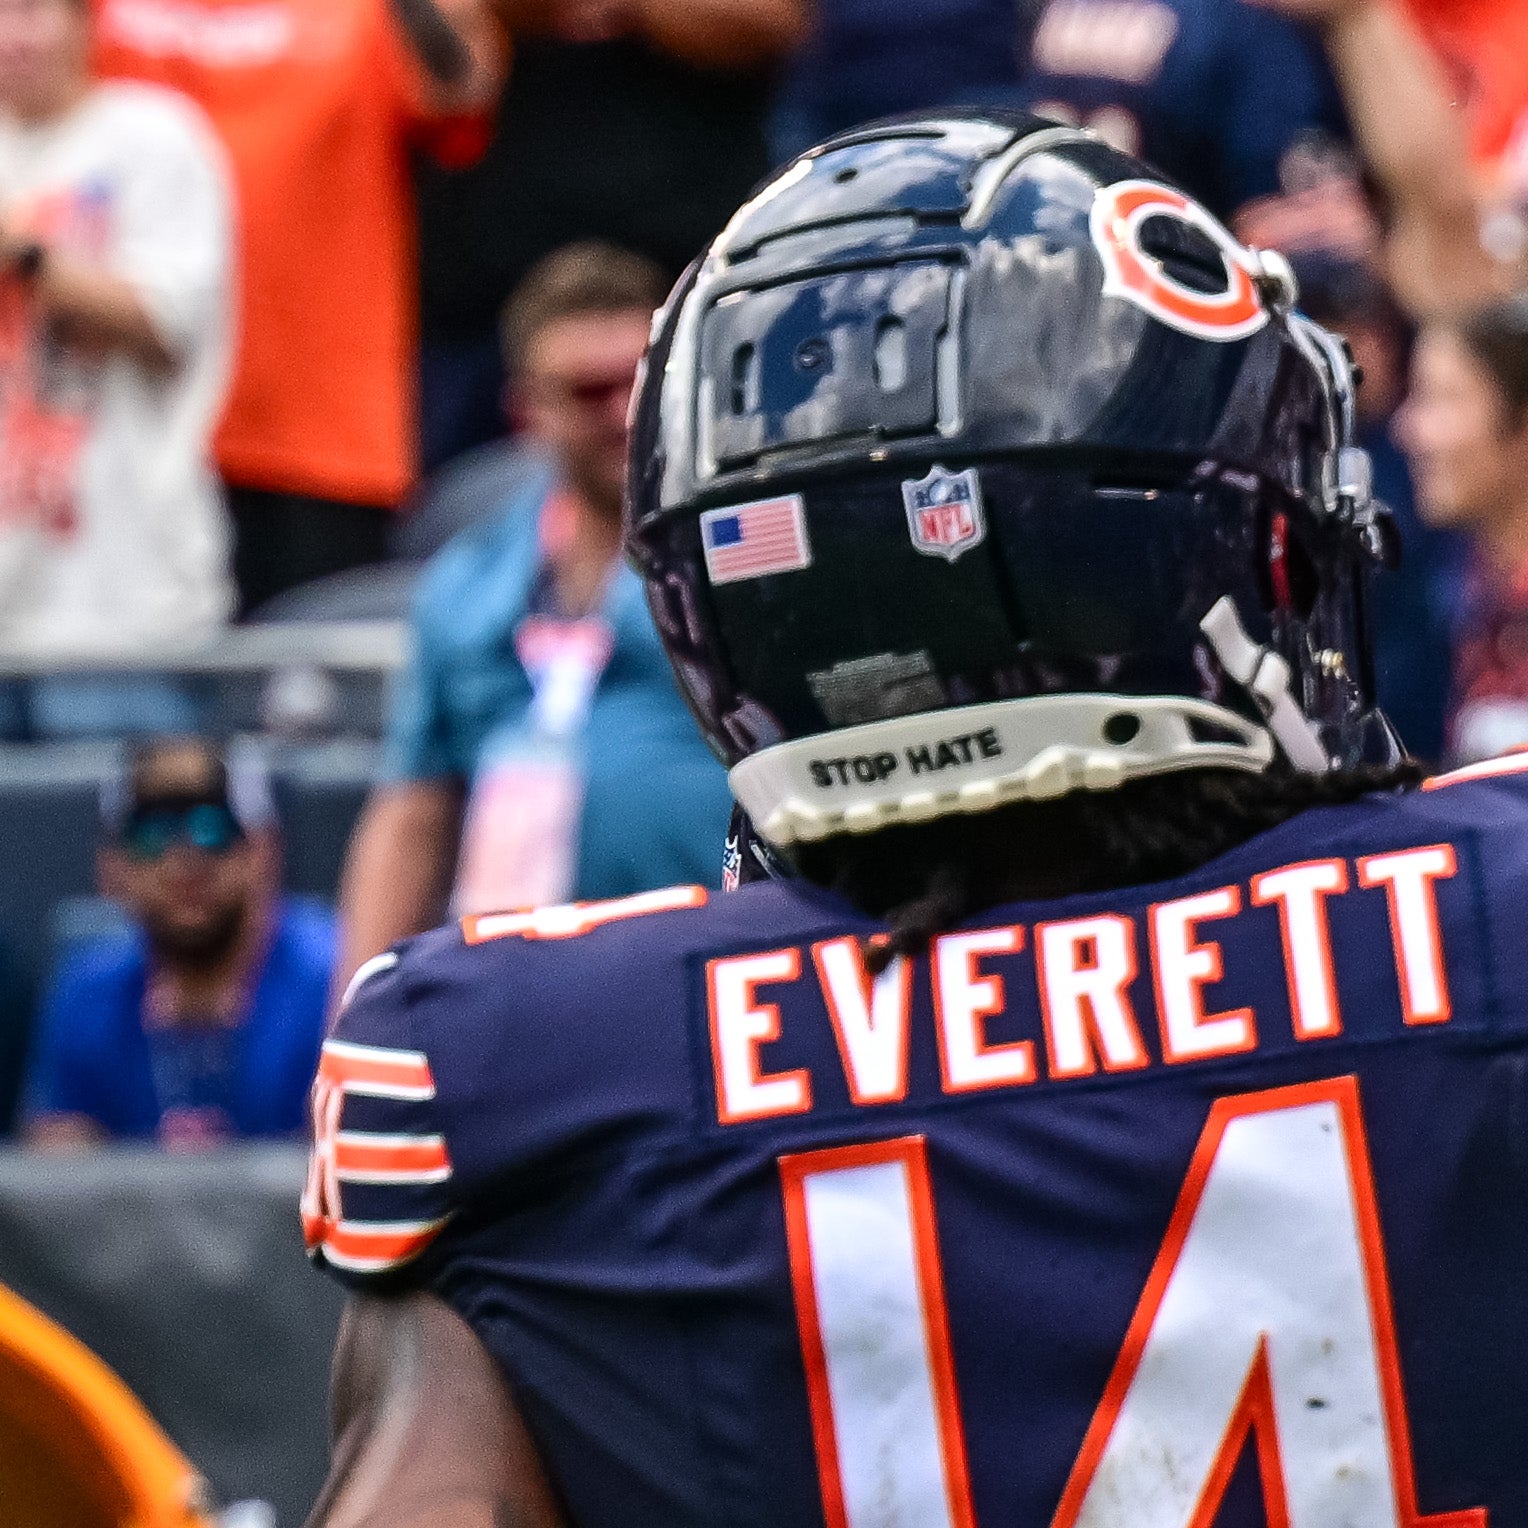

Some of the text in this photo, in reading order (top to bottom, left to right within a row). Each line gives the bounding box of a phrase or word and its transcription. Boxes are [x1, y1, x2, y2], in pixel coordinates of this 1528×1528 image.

[918, 504, 977, 544] NFL
[808, 725, 1002, 788] STOP HATE
[705, 843, 1457, 1125] EVERETT
